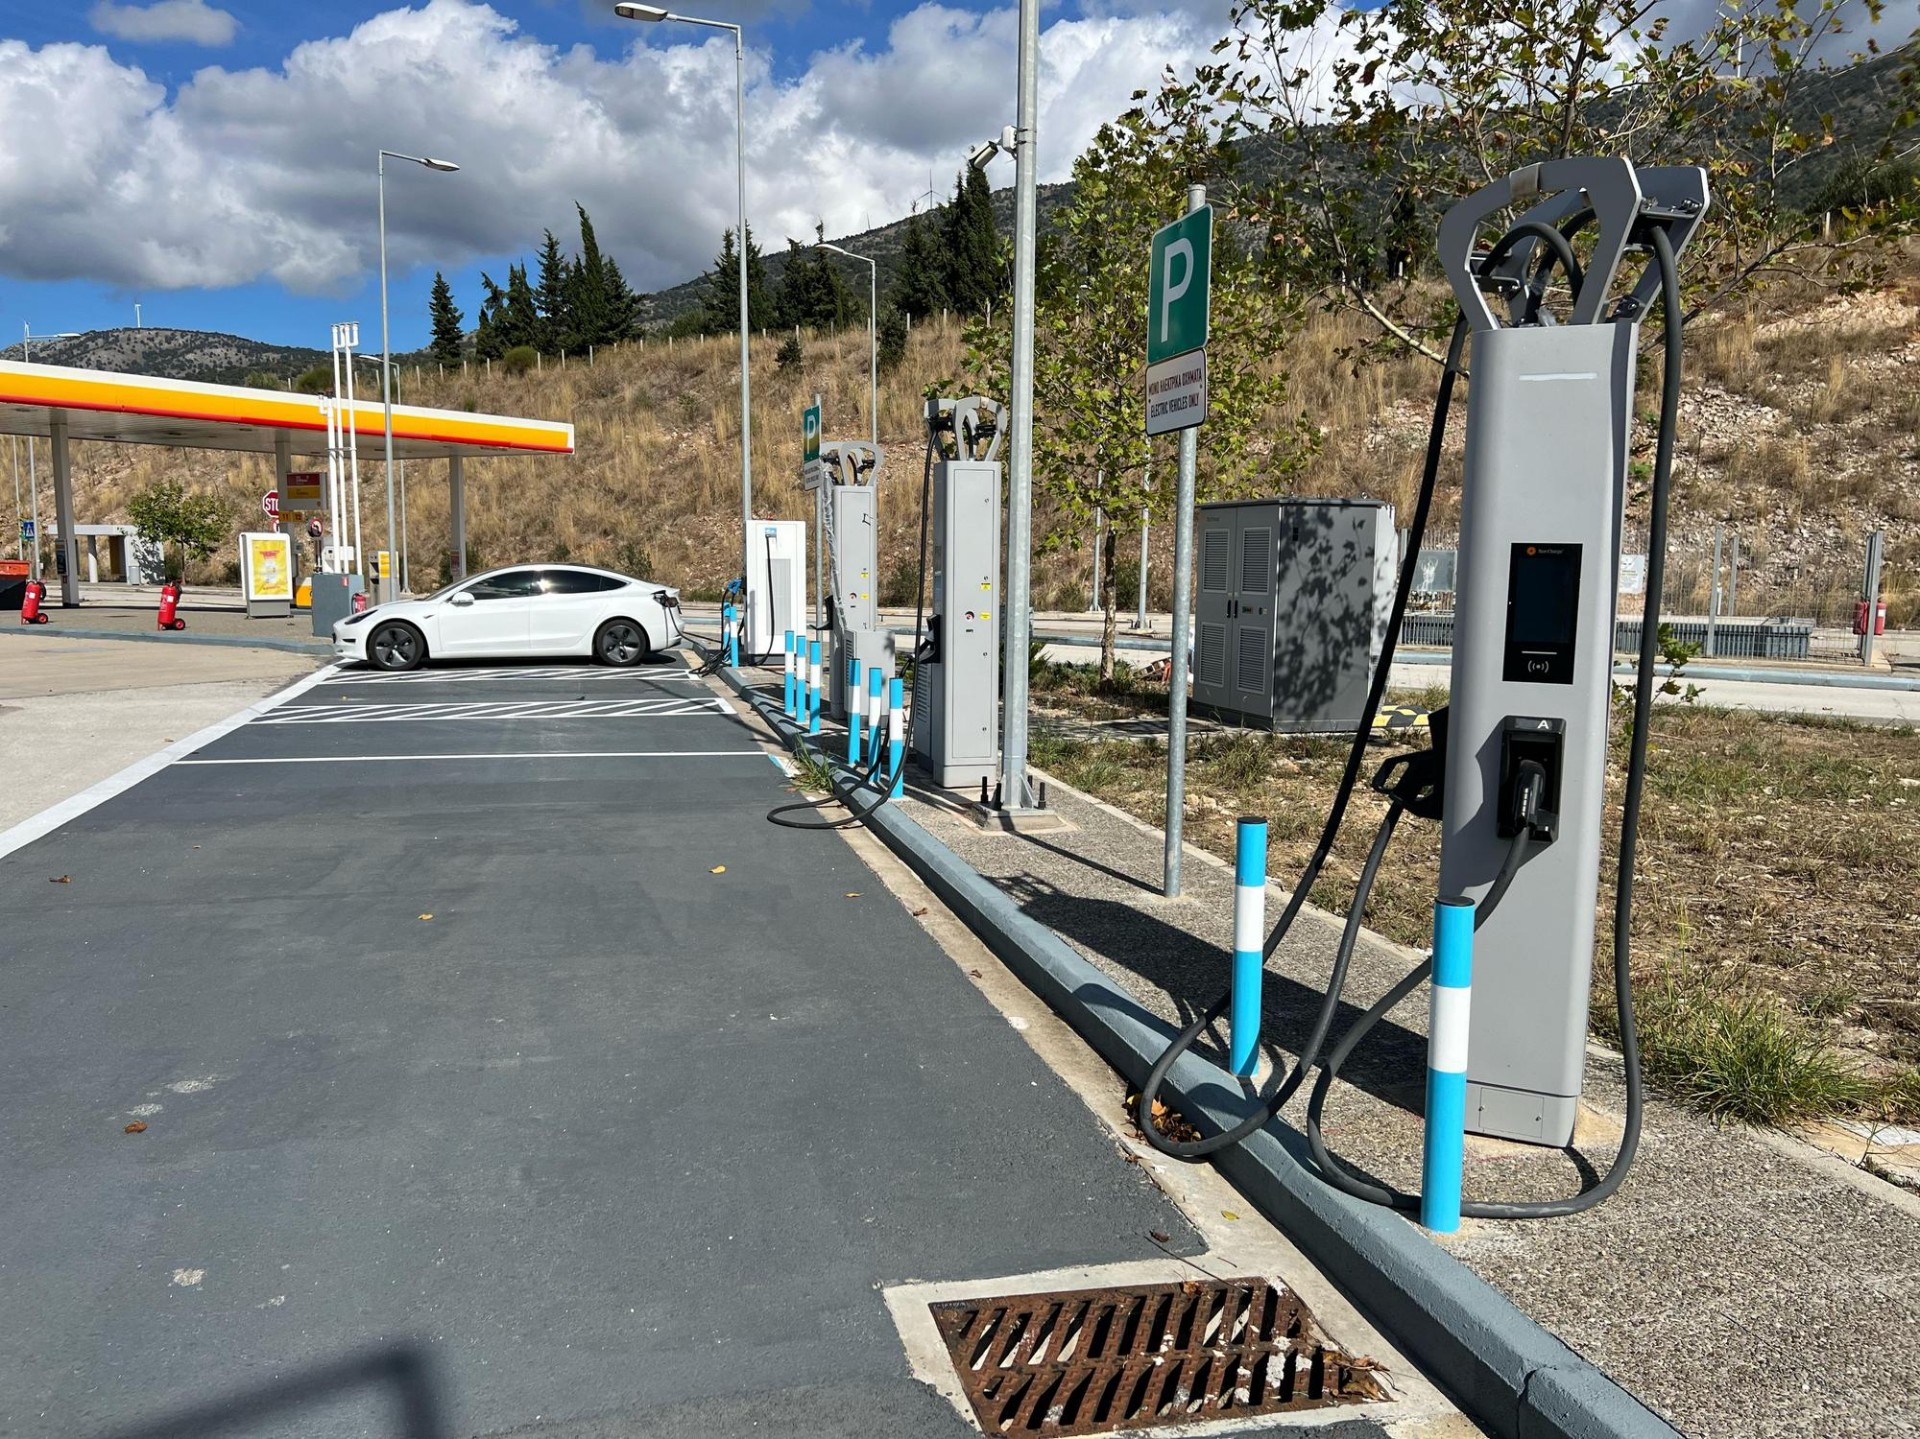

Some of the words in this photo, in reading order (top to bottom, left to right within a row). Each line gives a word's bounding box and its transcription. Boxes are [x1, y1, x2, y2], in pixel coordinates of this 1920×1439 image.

[1161, 238, 1194, 343] P
[1150, 401, 1168, 418] ELECTRIC
[1168, 395, 1188, 412] VEHICLES
[1188, 392, 1199, 408] ONLY
[807, 415, 816, 455] P
[1537, 719, 1549, 730] A
